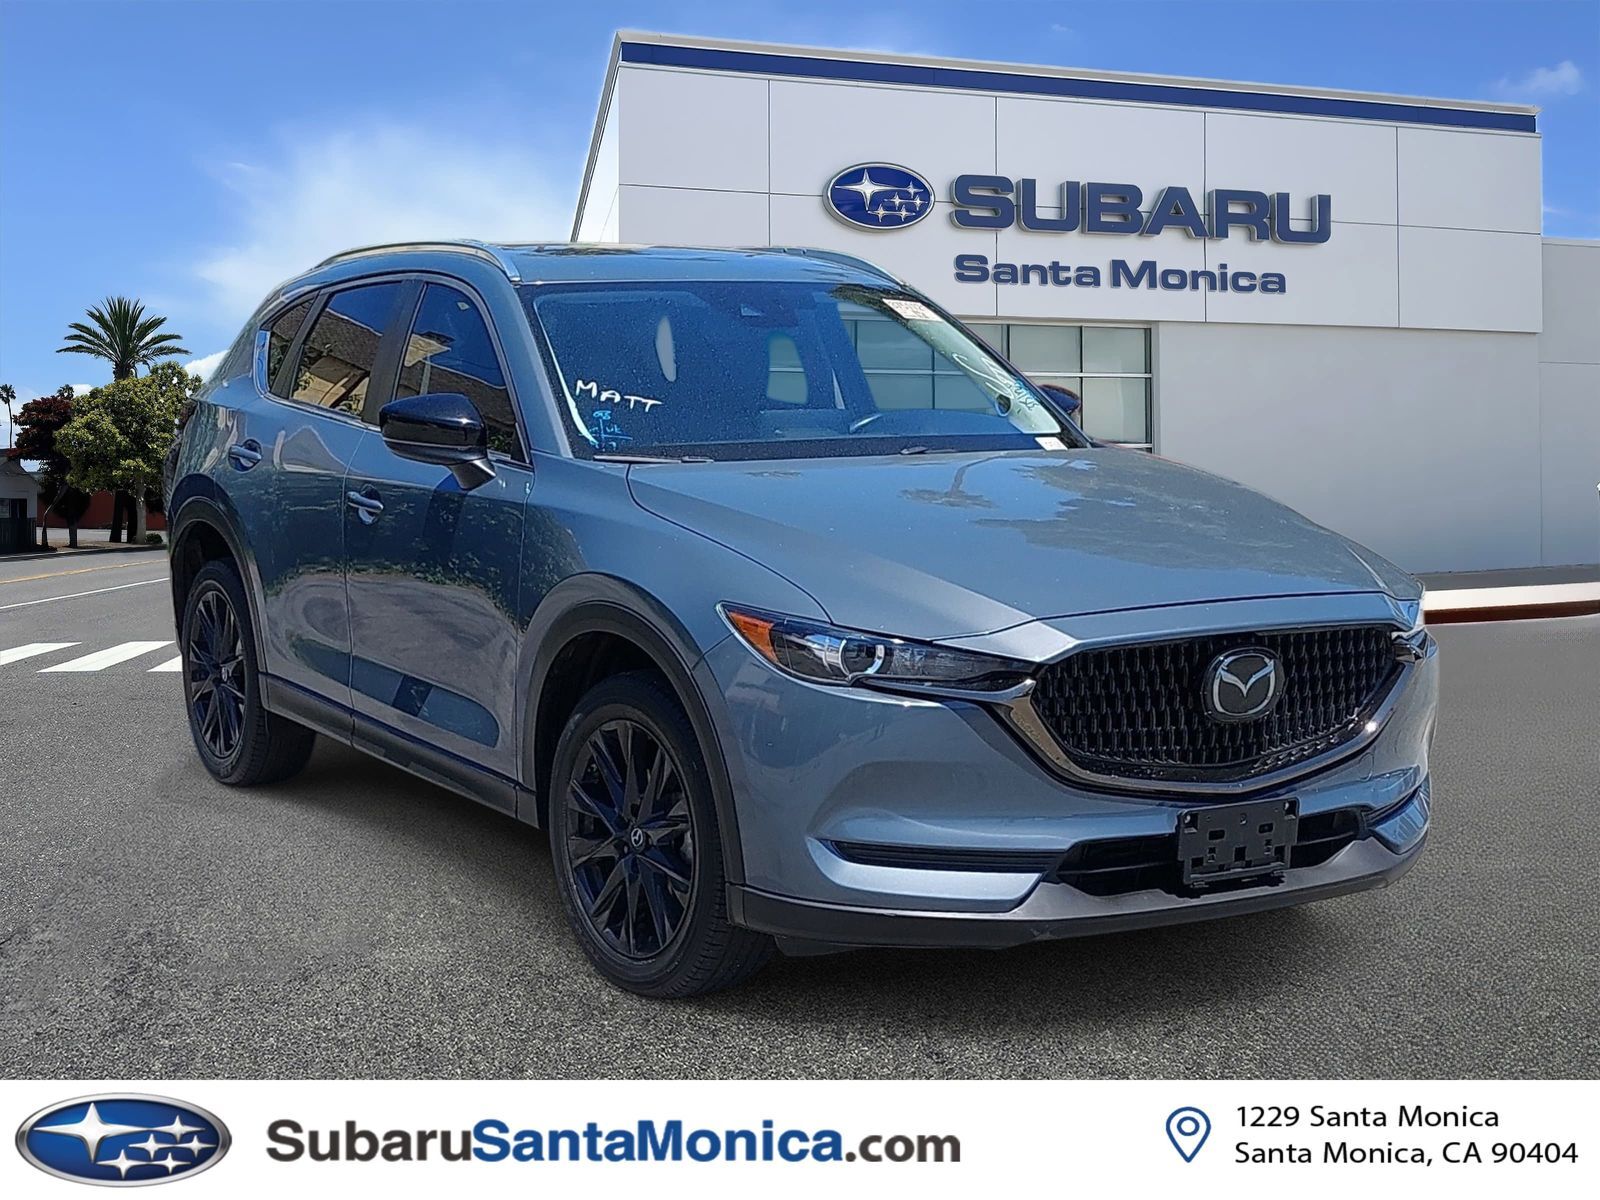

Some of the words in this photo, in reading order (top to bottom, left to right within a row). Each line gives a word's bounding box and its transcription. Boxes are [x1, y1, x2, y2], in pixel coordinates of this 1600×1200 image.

[952, 174, 1332, 245] SUBARU
[953, 253, 1102, 289] Santa
[1111, 259, 1288, 294] Monica
[575, 379, 663, 413] MATT
